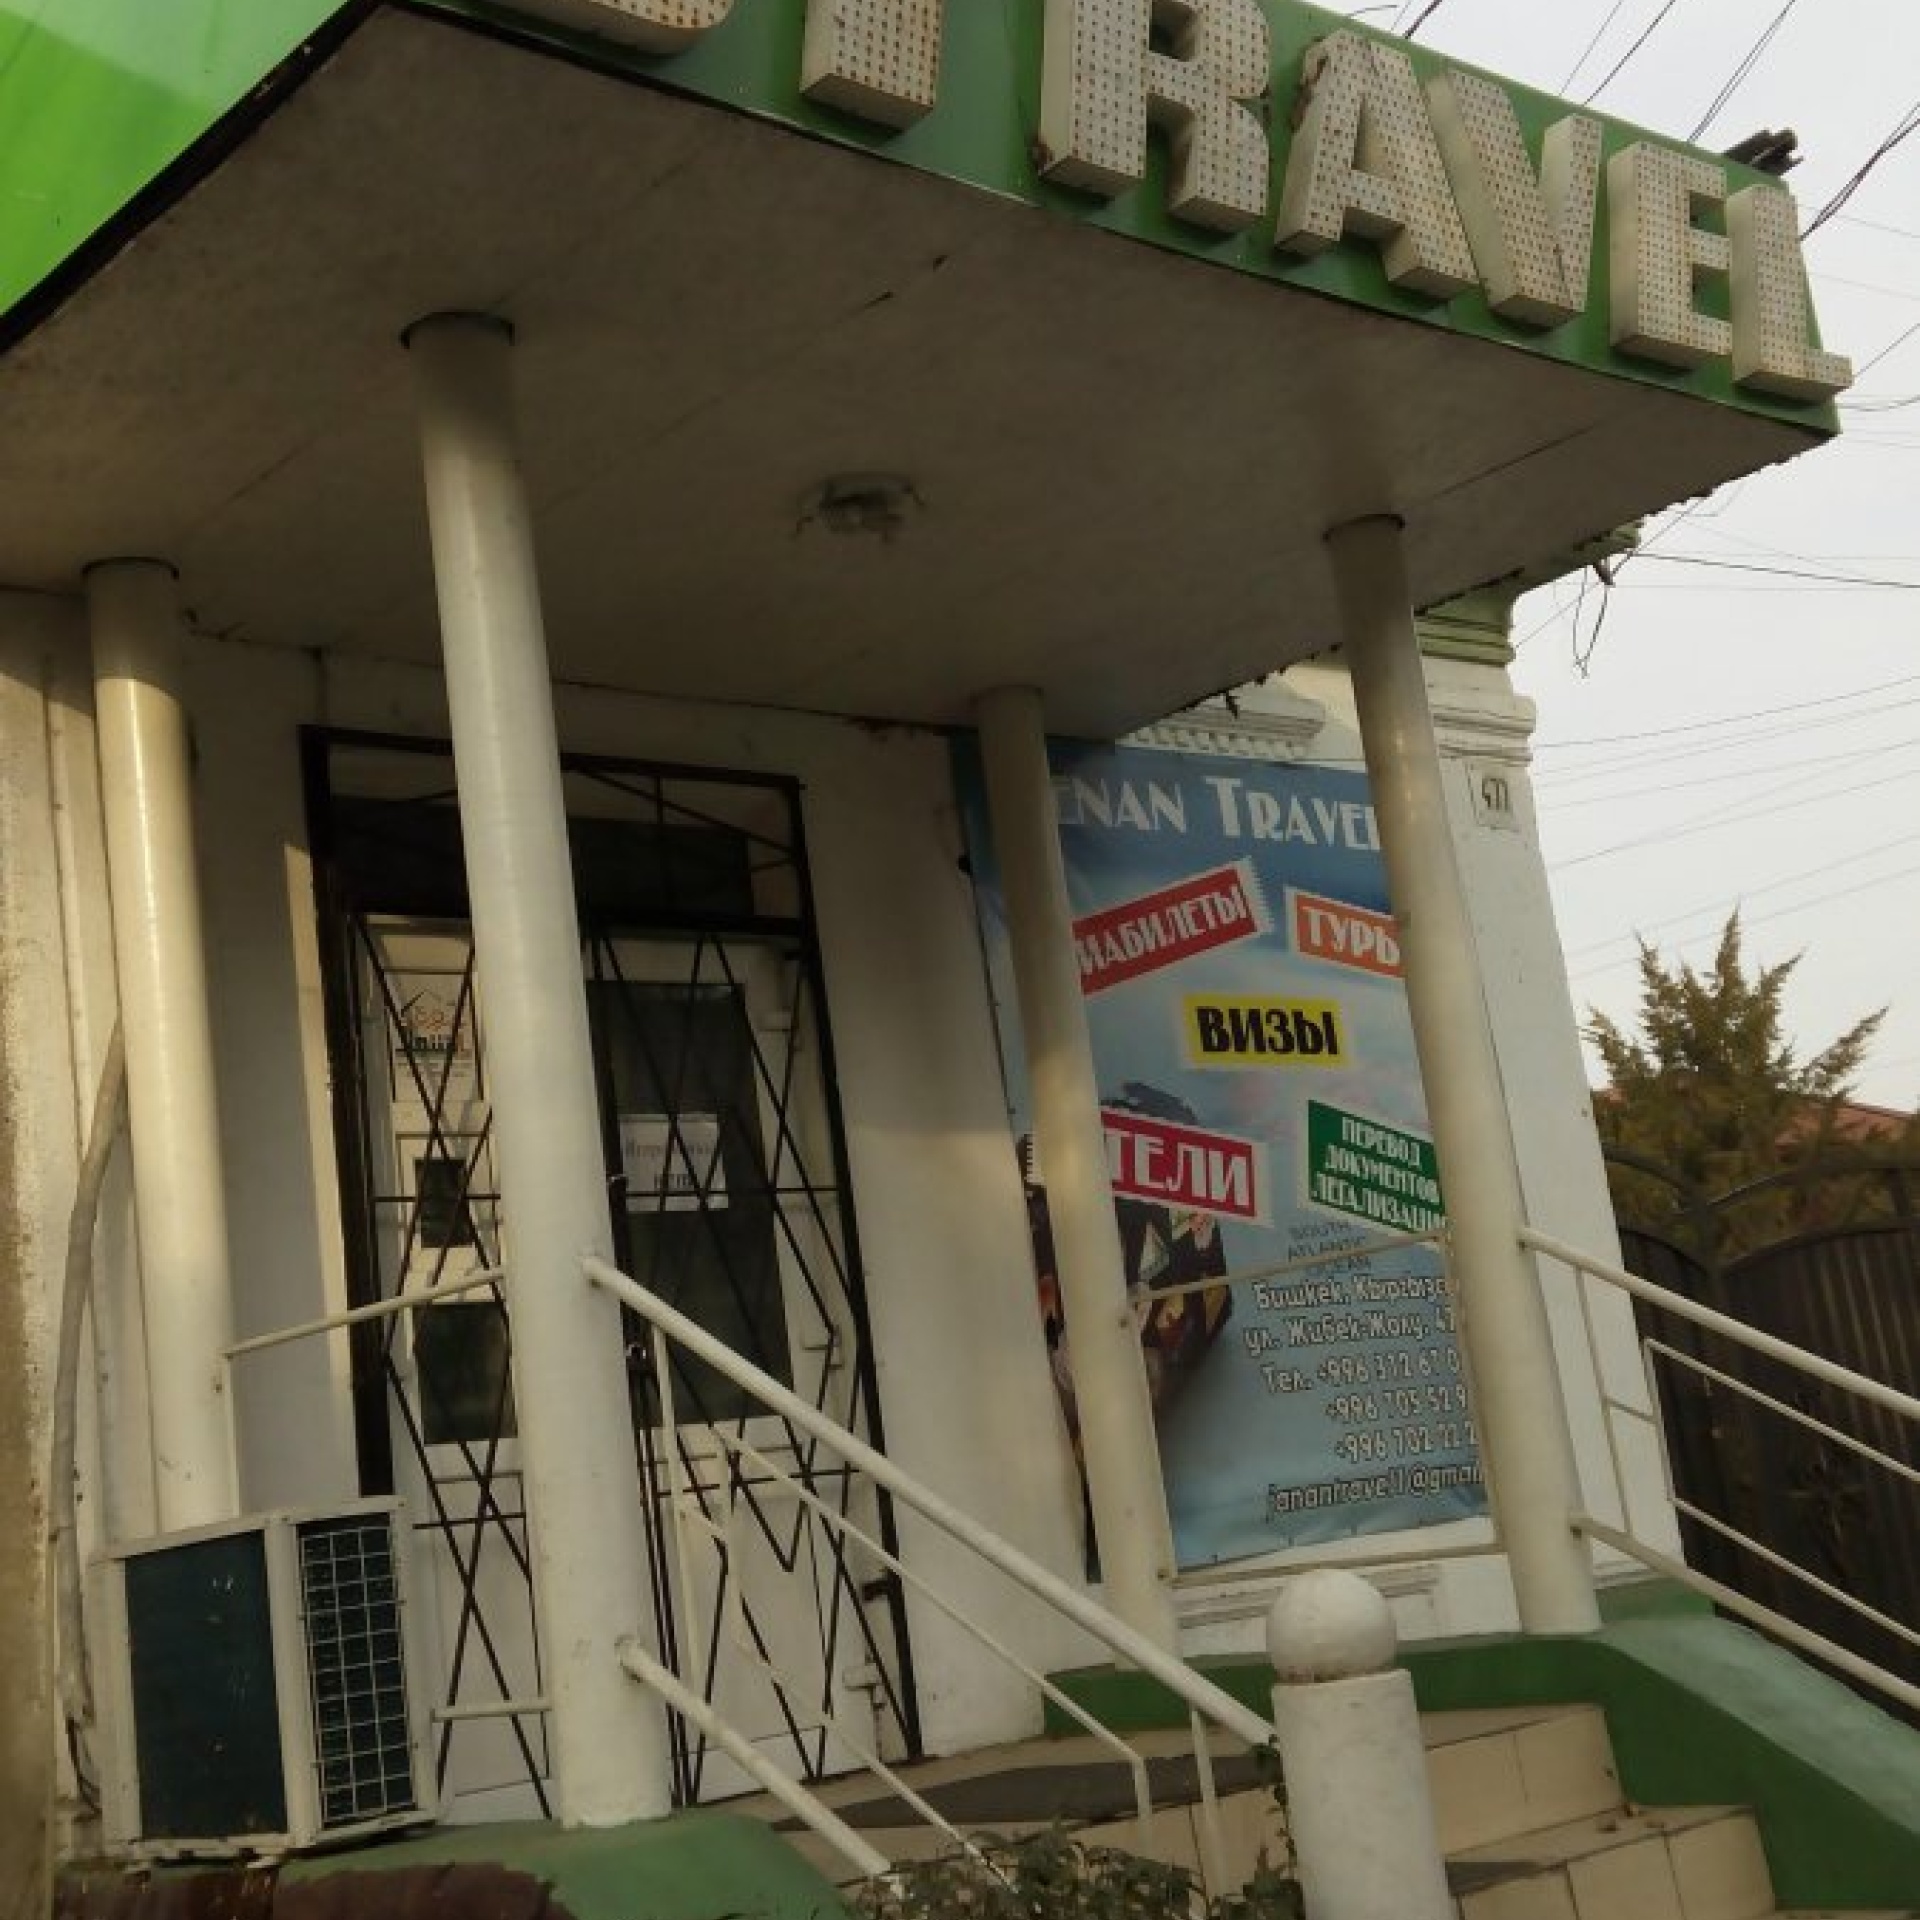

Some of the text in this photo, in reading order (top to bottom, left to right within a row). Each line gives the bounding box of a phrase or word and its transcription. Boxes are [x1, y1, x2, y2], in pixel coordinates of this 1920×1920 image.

[1196, 1006, 1339, 1055] ВИЗЫ
[1341, 1116, 1422, 1170] ПЕРЕВОД
[1317, 1354, 1370, 1387] +996
[1325, 1391, 1379, 1423] +996
[1335, 1429, 1388, 1462] +996
